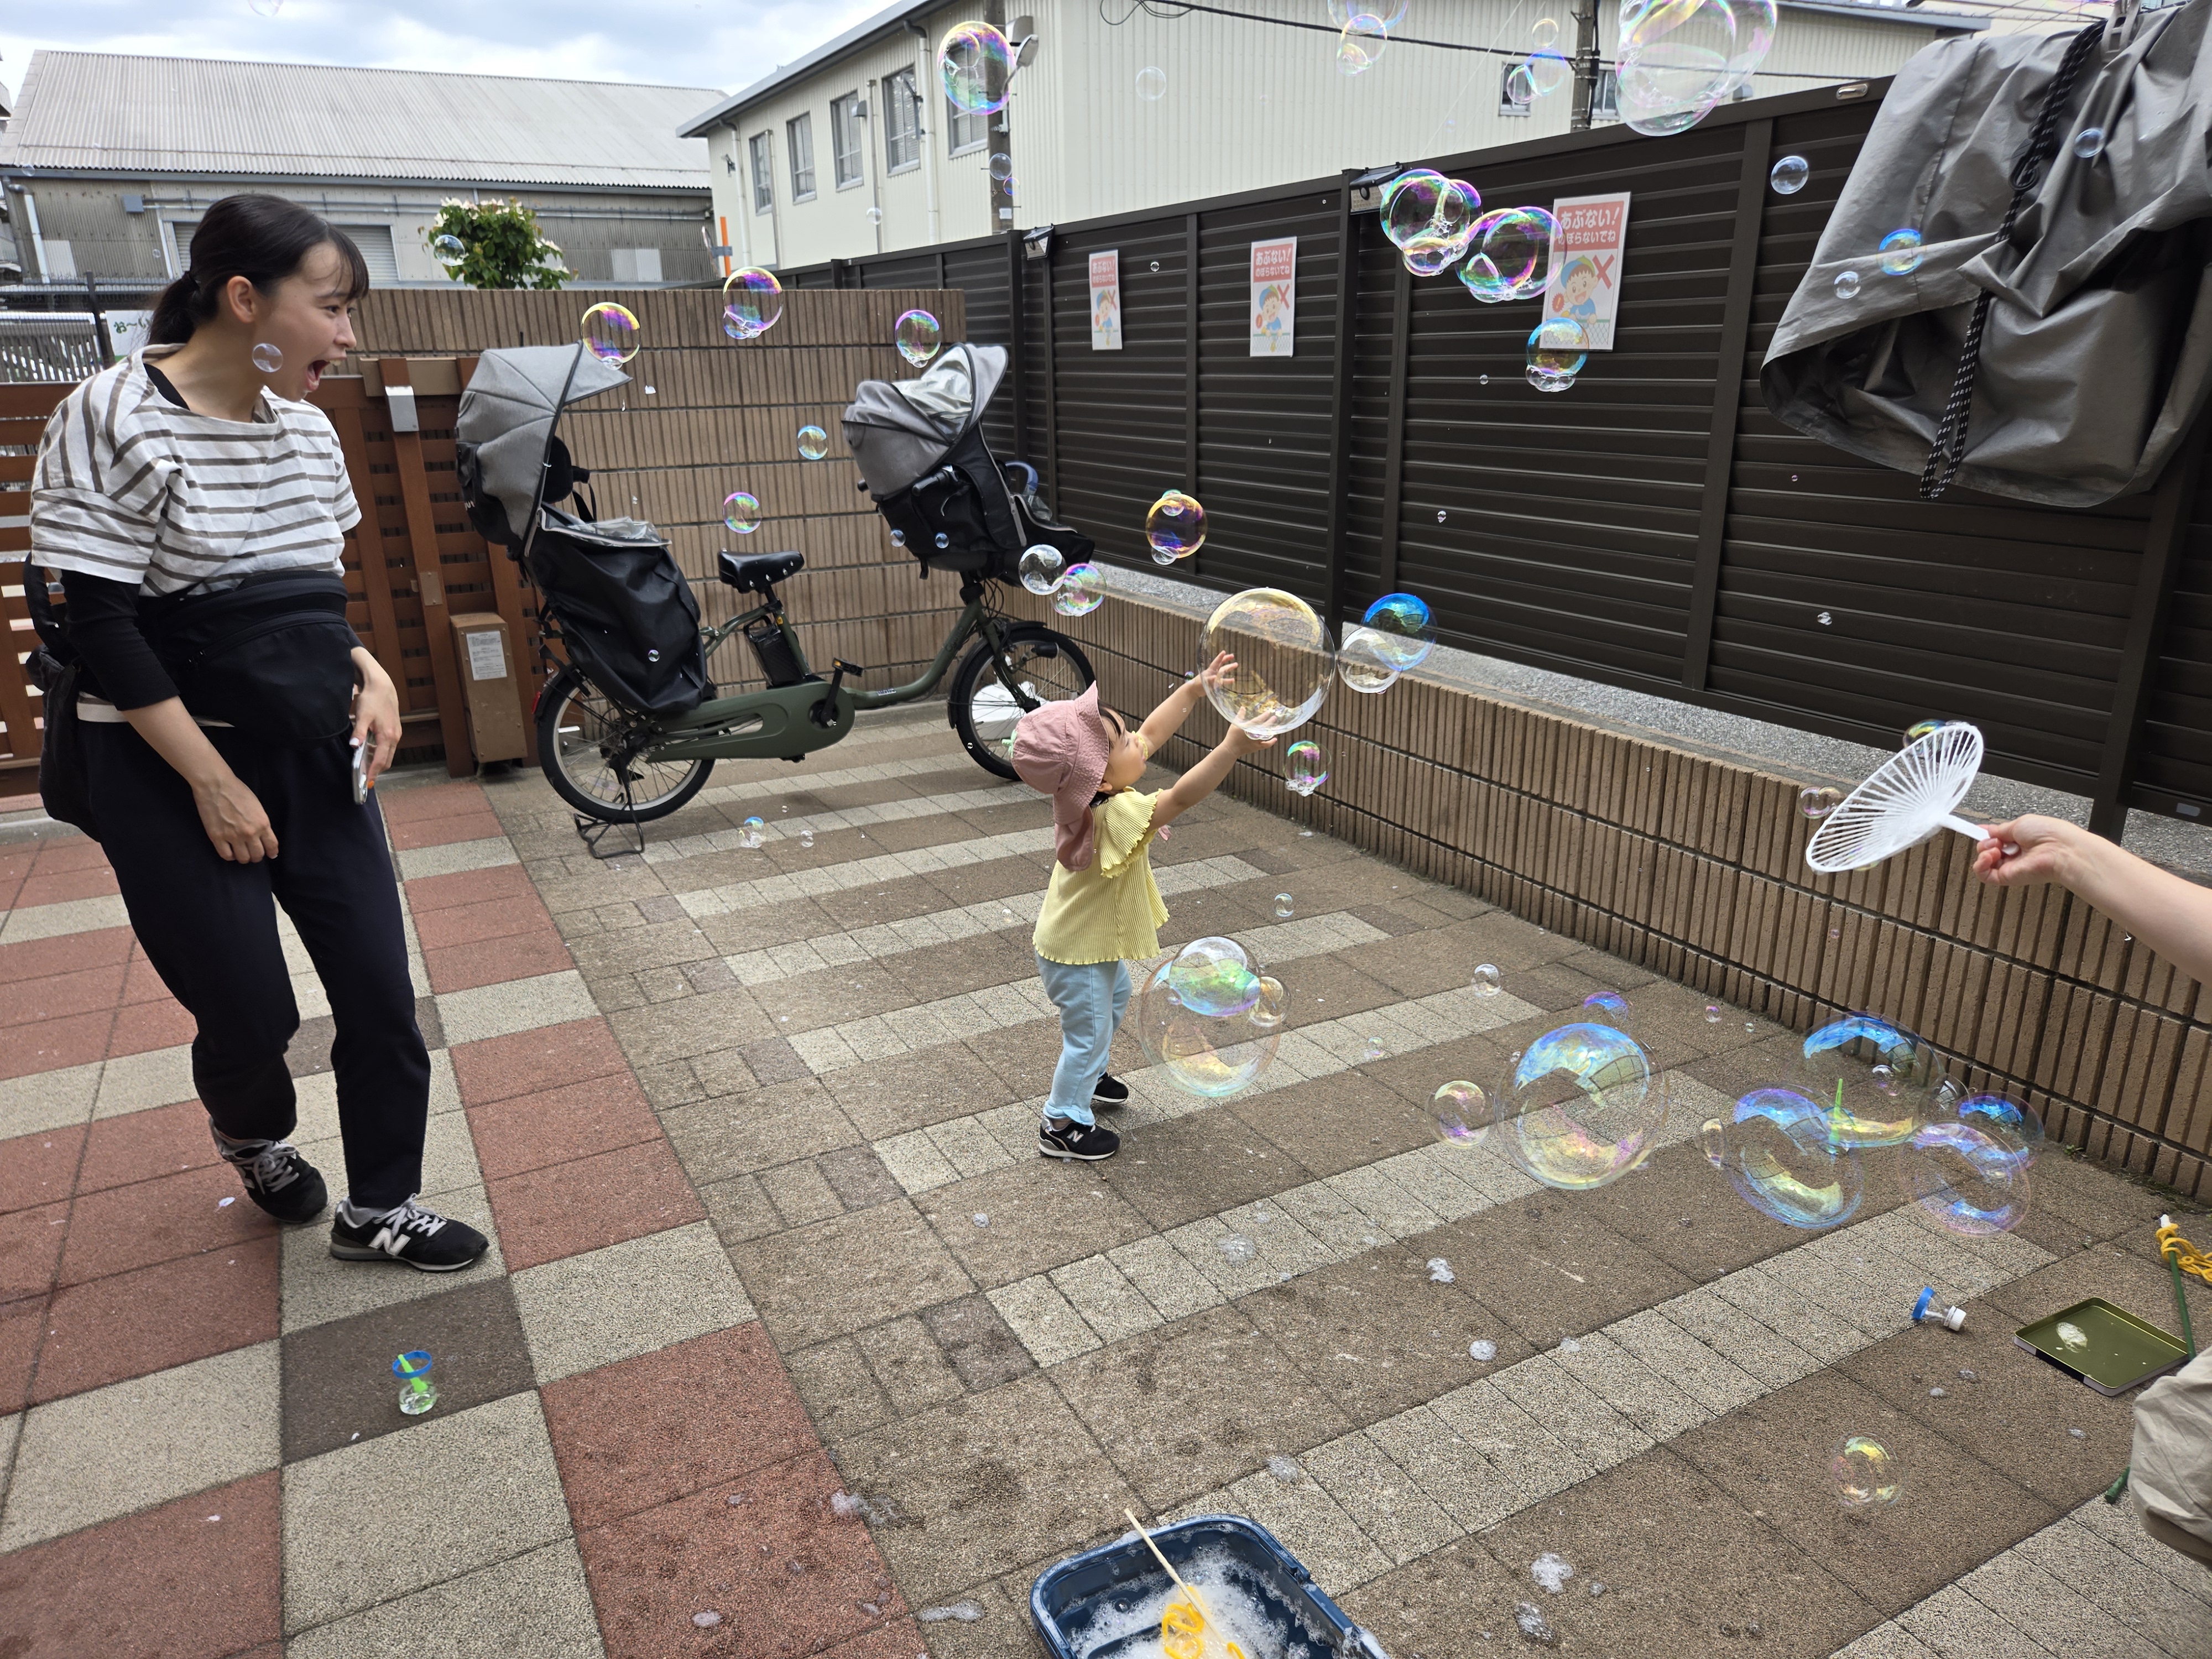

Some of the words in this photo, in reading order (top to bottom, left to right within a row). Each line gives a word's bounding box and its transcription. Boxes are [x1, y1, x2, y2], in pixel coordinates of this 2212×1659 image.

[1561, 207, 1620, 230] あぶない!
[1066, 1129, 1084, 1143] N
[369, 1227, 411, 1257] N
